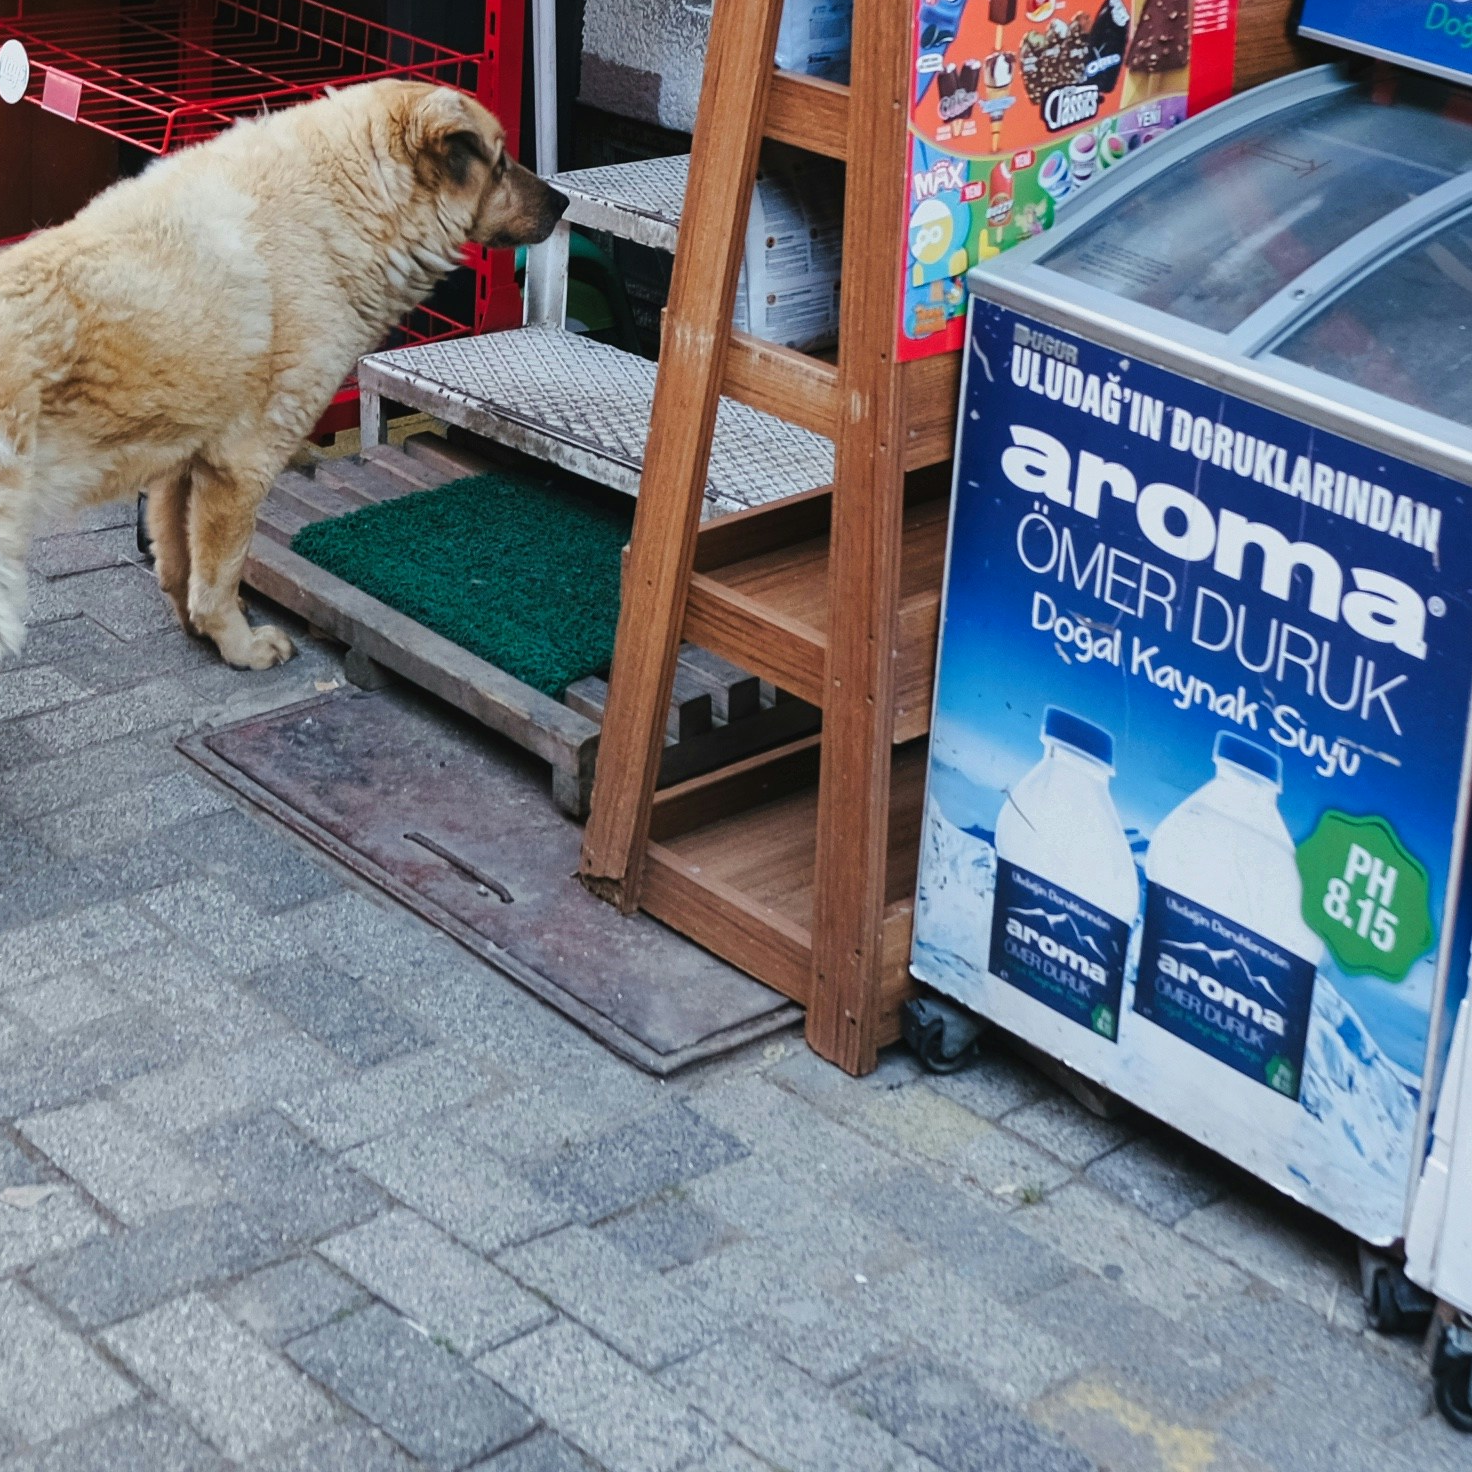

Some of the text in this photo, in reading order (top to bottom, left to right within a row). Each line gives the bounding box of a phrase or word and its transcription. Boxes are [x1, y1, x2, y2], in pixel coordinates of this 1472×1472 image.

[914, 160, 966, 201] MAX
[1011, 346, 1443, 554] ULUDAĞ'IN DORUKLARINDAN
[1000, 423, 1429, 661] aroma
[1015, 499, 1409, 737] ÖMER DURUK
[1031, 590, 1362, 777] Doğal Kaynak Suyu
[1321, 878, 1400, 955] 8.15
[1344, 842, 1399, 910] PH
[1005, 916, 1108, 987] aroma
[1156, 951, 1286, 1038] aroma
